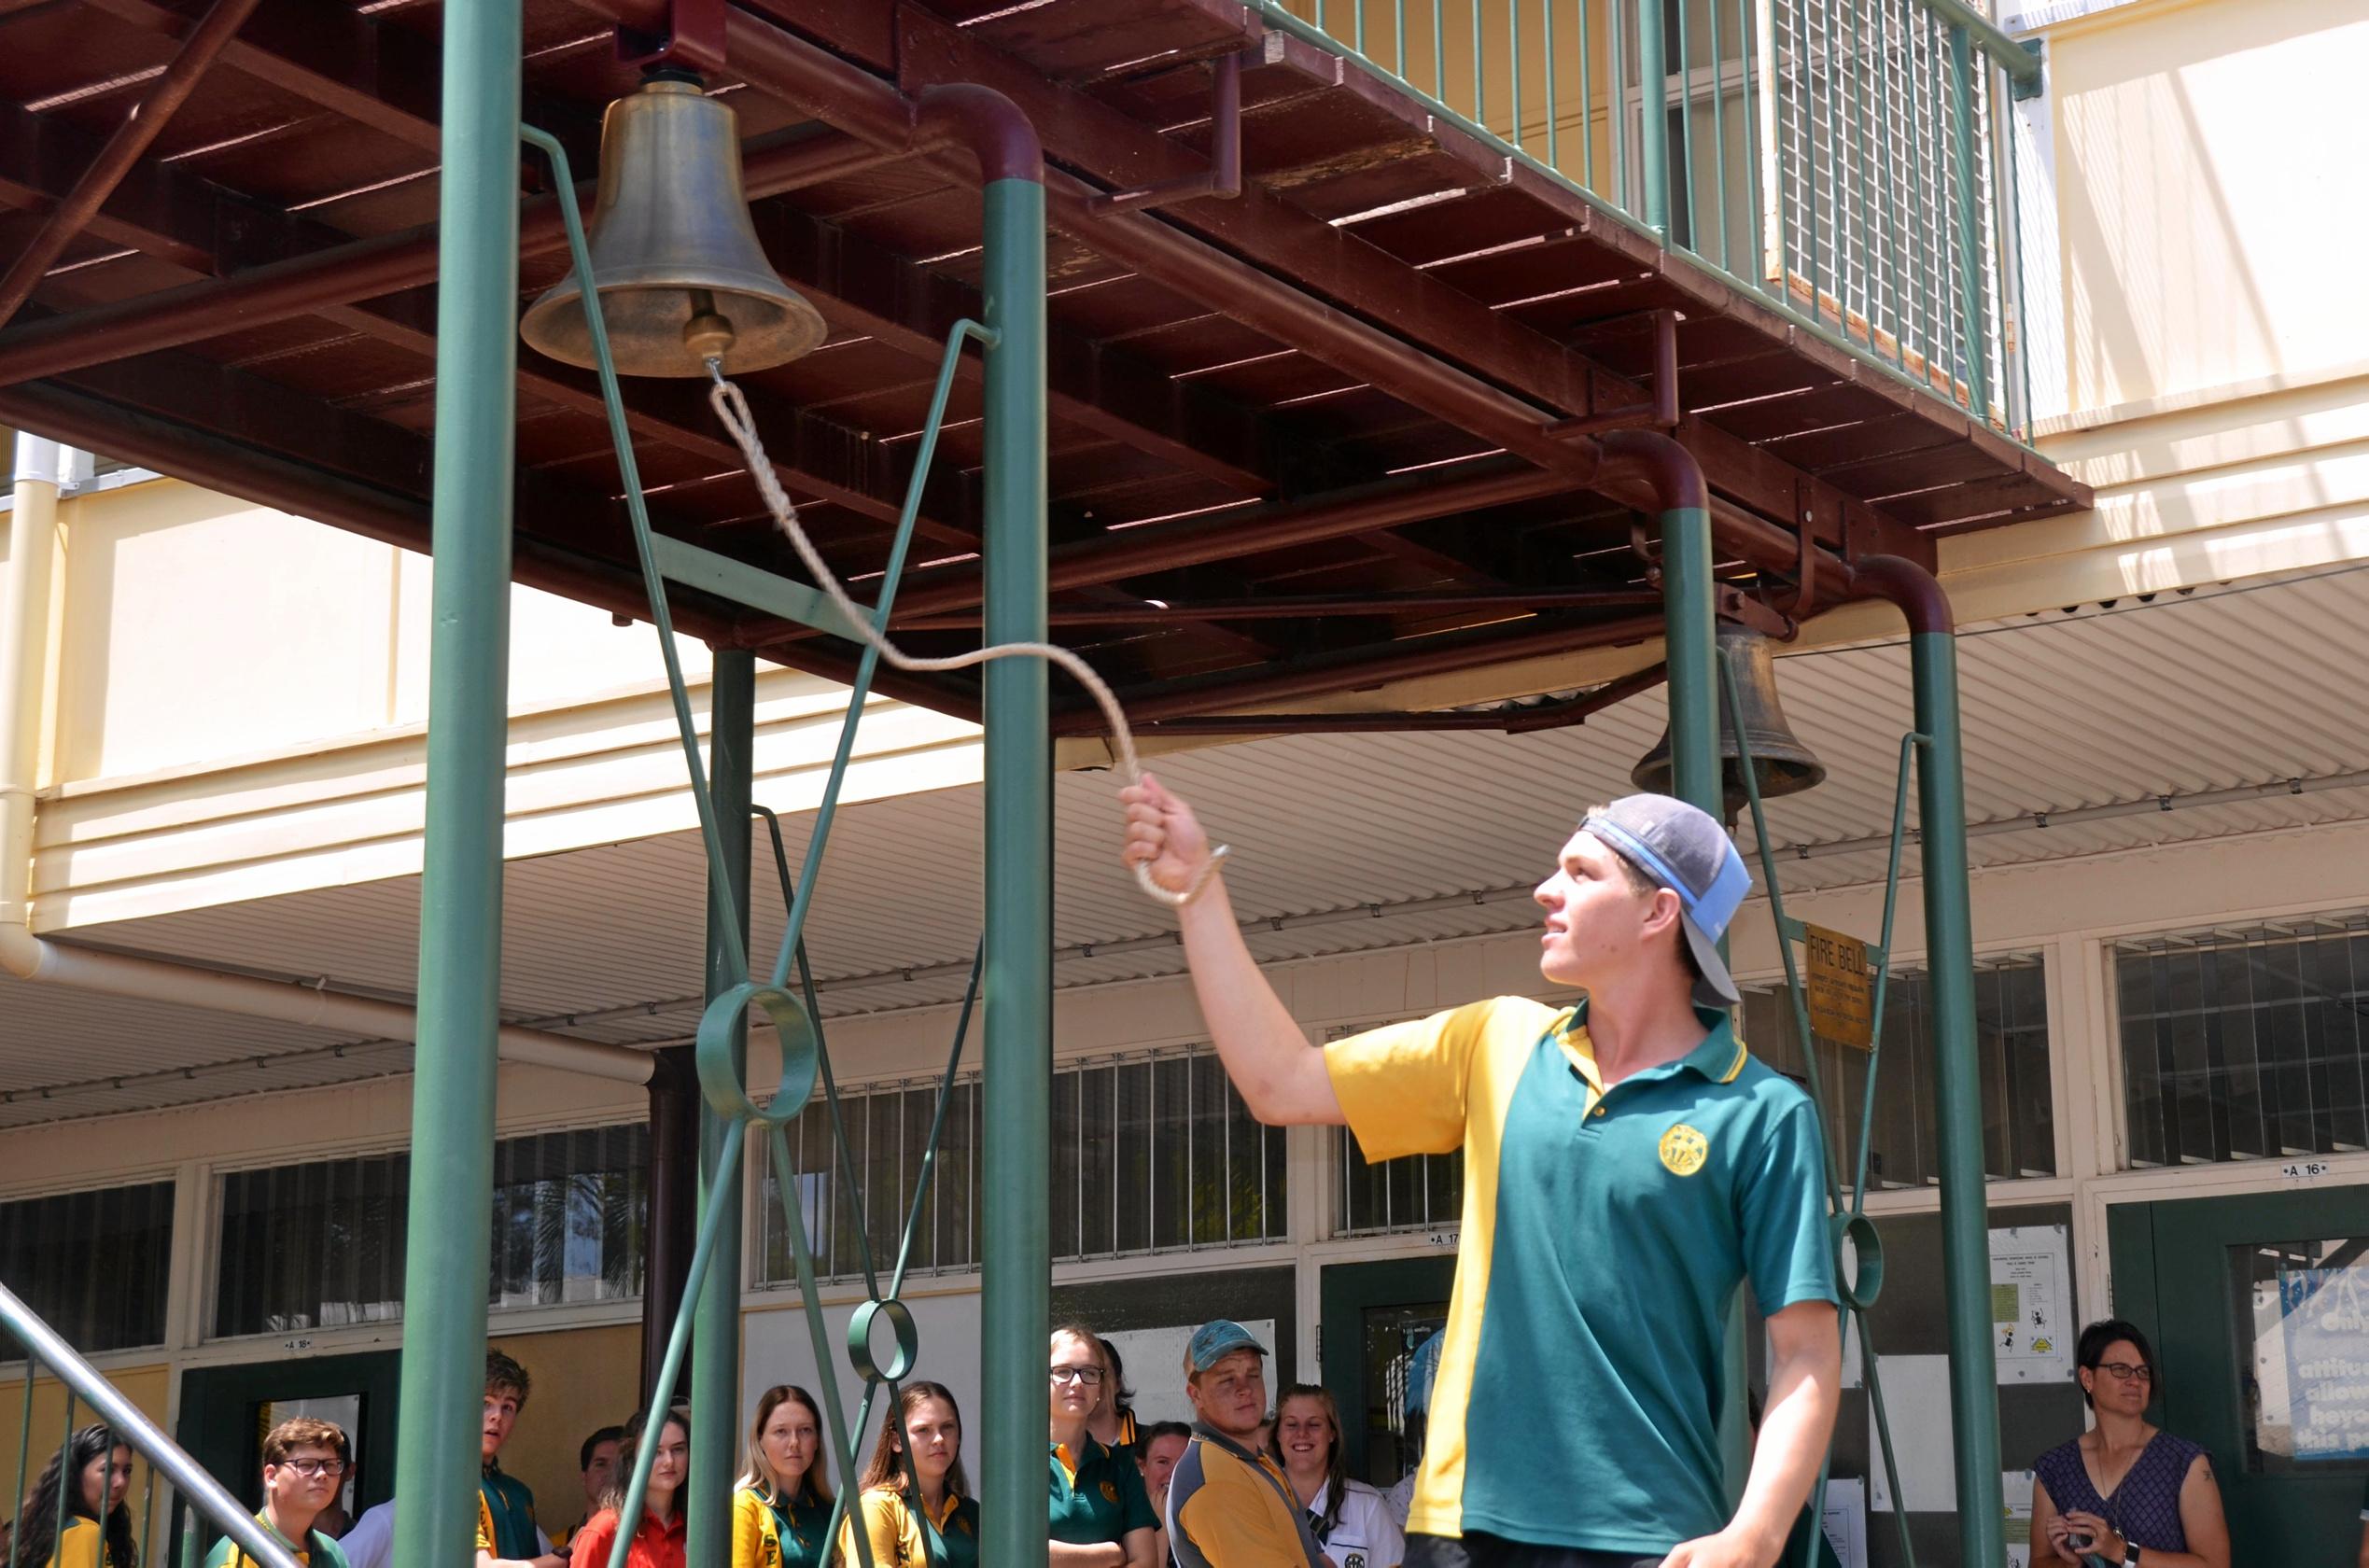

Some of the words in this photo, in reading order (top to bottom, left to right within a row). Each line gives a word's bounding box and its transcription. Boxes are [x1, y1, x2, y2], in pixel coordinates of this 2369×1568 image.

[1810, 934, 1834, 967] FIRE
[1839, 943, 1865, 976] BELL
[2290, 1165, 2299, 1177] A
[2306, 1163, 2320, 1176] 16
[1436, 1234, 1443, 1244] A
[1449, 1232, 1459, 1244] 17
